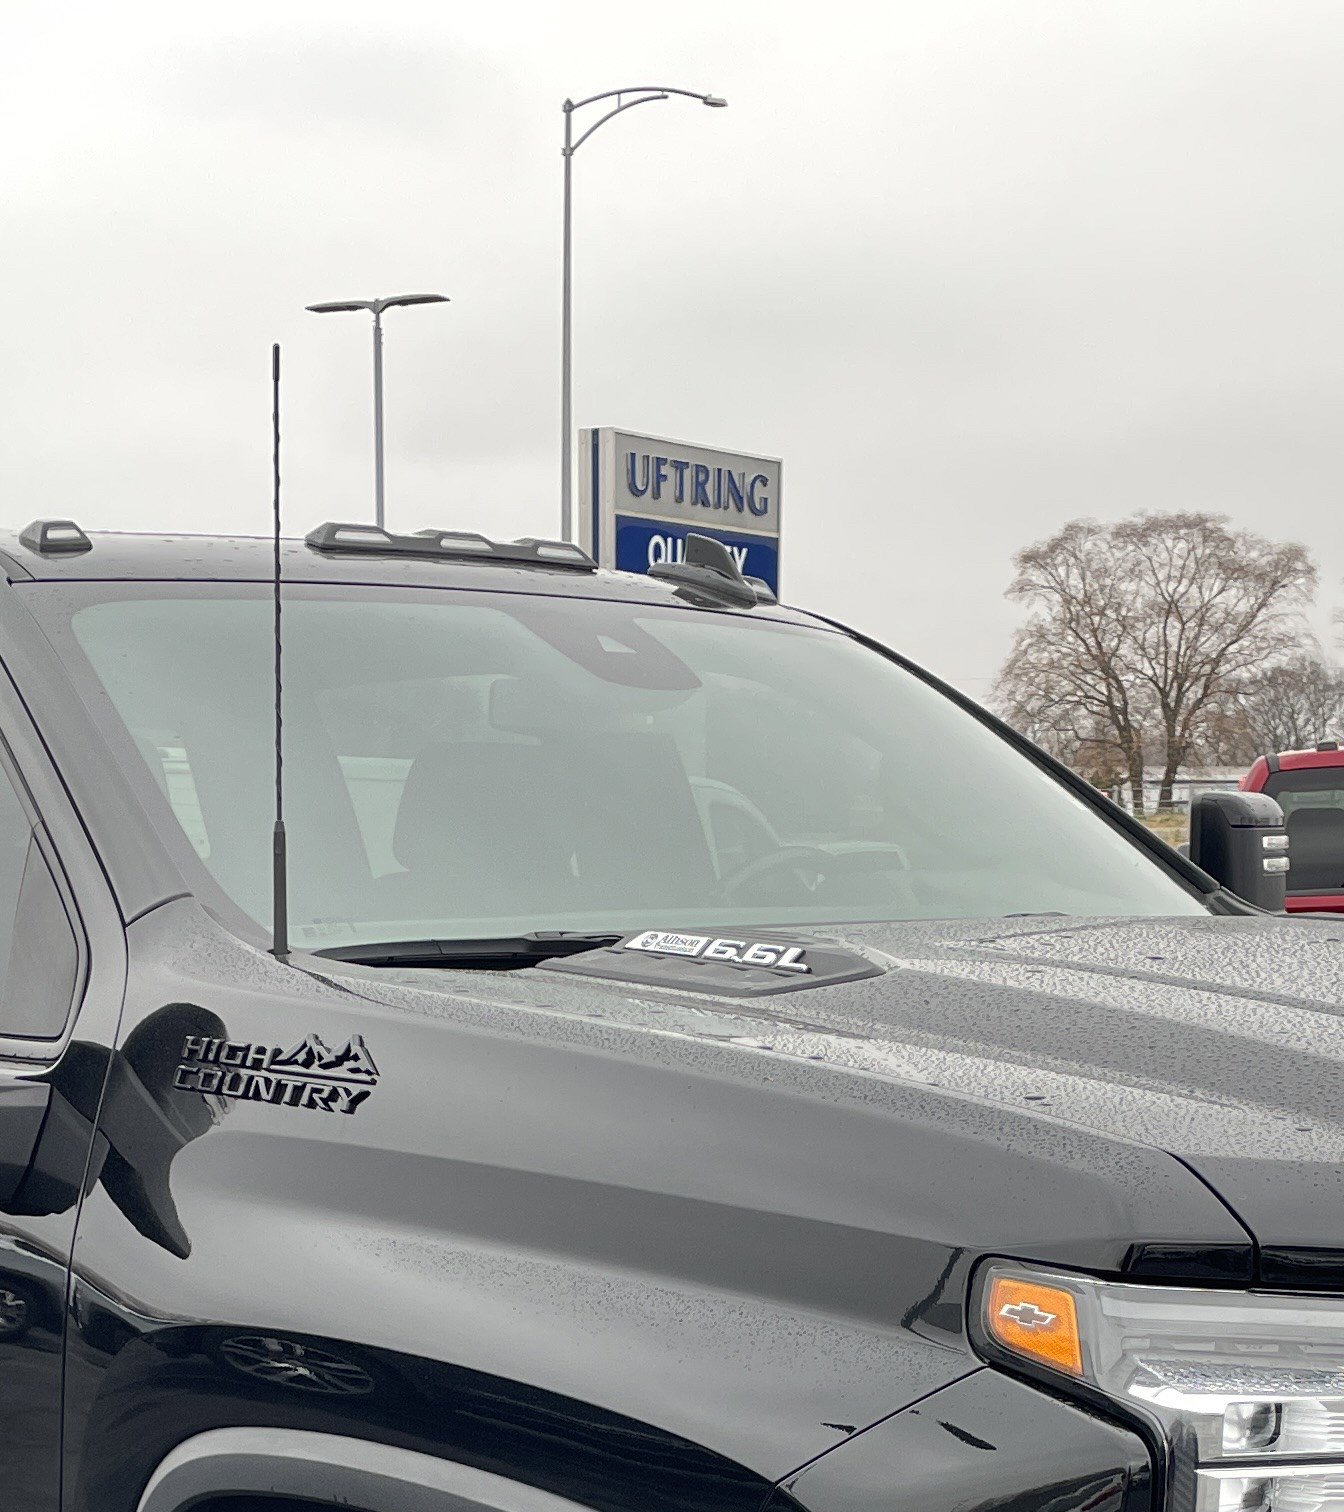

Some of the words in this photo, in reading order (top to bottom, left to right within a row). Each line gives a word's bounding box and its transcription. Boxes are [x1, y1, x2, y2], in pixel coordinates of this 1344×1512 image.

[625, 451, 769, 517] UFTRING
[703, 938, 812, 974] 6.6L
[180, 1034, 277, 1071] HIGH
[172, 1064, 372, 1115] COUNTRY
